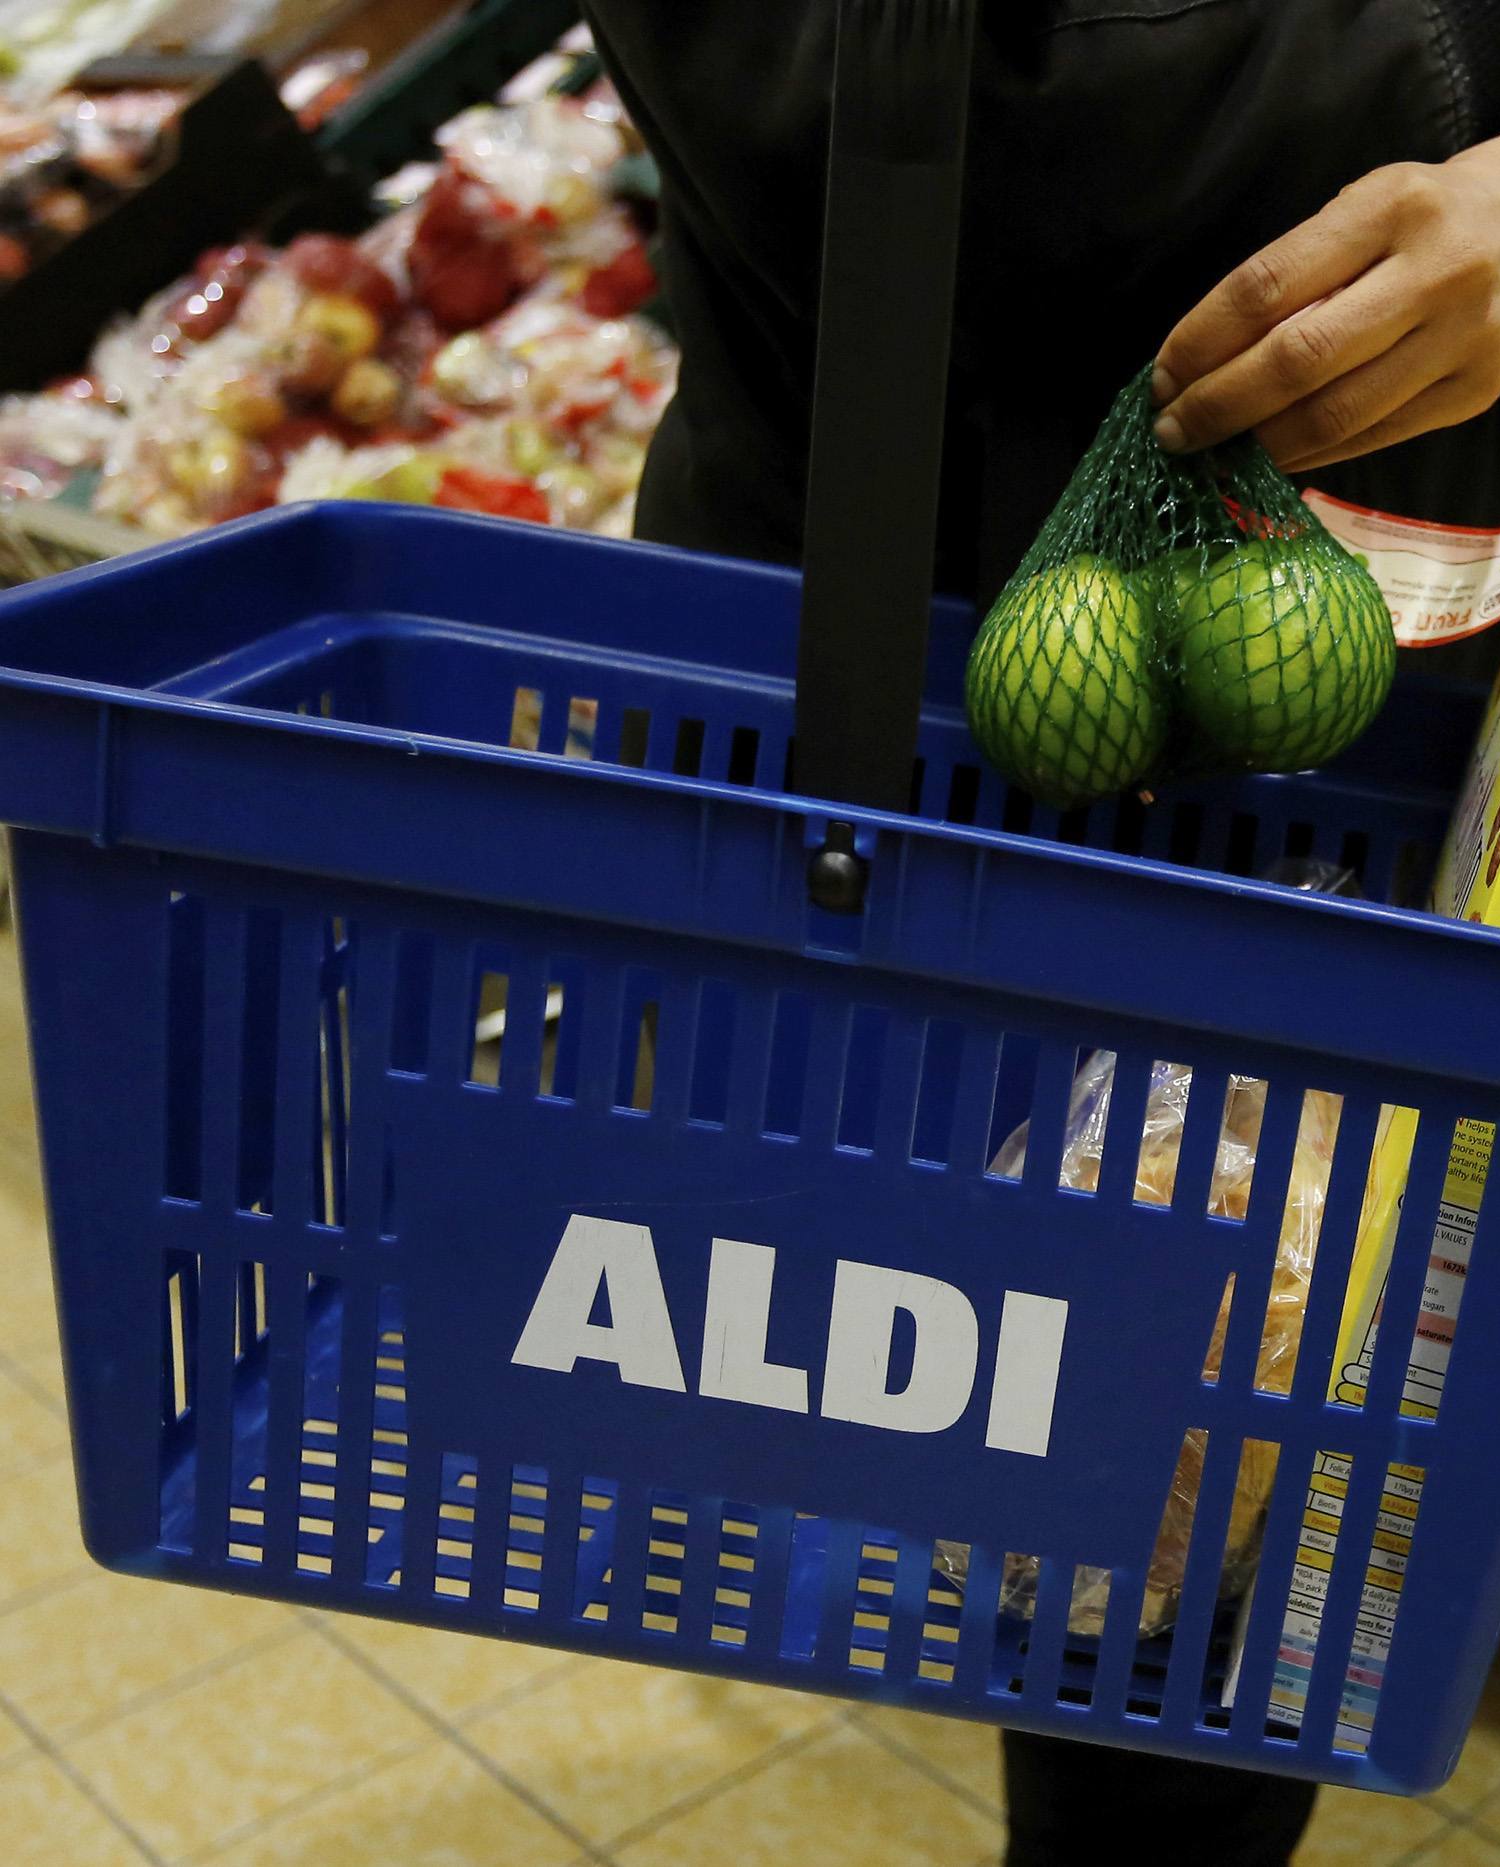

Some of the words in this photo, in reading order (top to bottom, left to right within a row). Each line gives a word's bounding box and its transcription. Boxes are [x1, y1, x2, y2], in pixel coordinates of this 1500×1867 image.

[1465, 1119, 1489, 1134] helps
[1441, 1231, 1467, 1246] VALUES
[1443, 1261, 1467, 1275] 1672k
[1422, 1300, 1445, 1313] sugars
[511, 1214, 1068, 1457] ALDI
